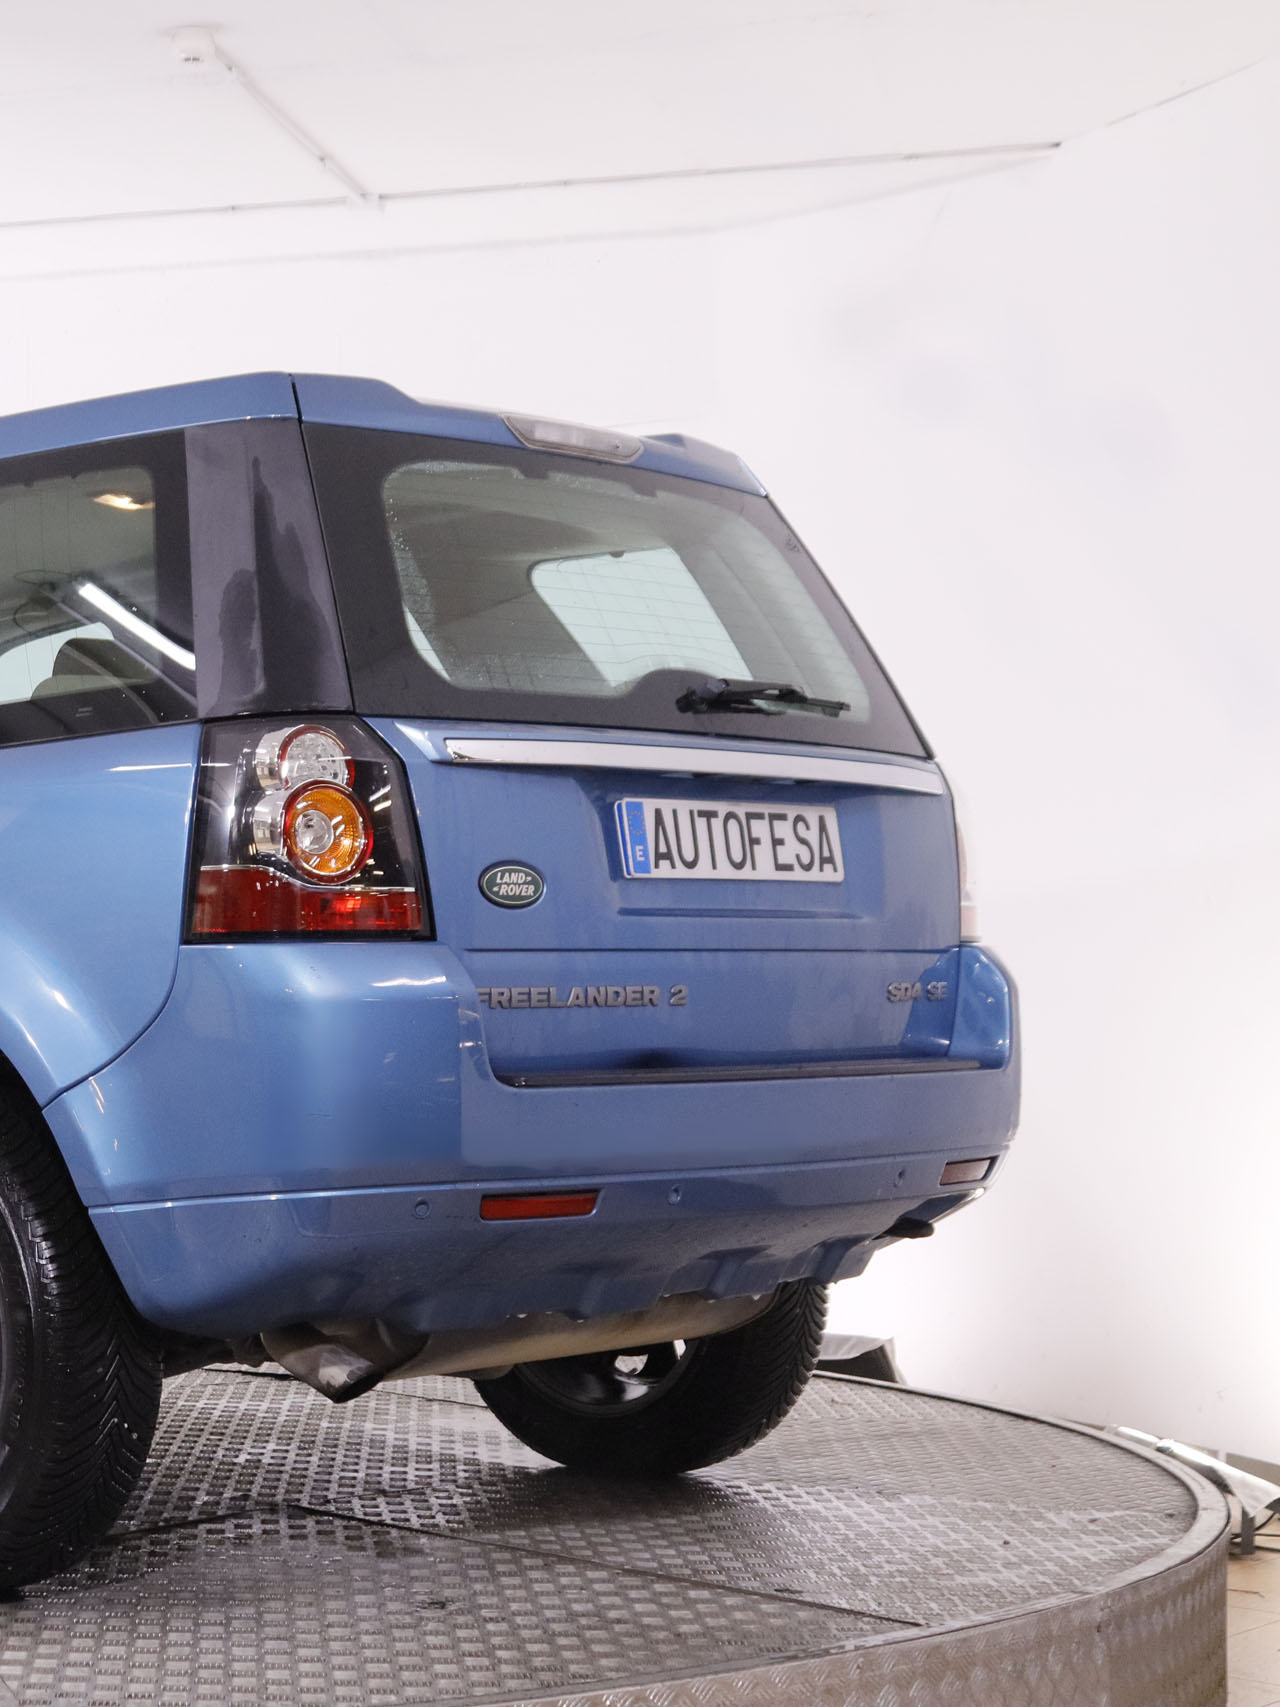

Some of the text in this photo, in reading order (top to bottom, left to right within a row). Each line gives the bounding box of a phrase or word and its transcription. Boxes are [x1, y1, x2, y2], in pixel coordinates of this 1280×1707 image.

[654, 808, 838, 873] AUTOFESA
[636, 846, 645, 861] E
[496, 872, 526, 883] LAND
[499, 884, 535, 896] ROVER
[476, 984, 687, 1009] FREELANDER 2
